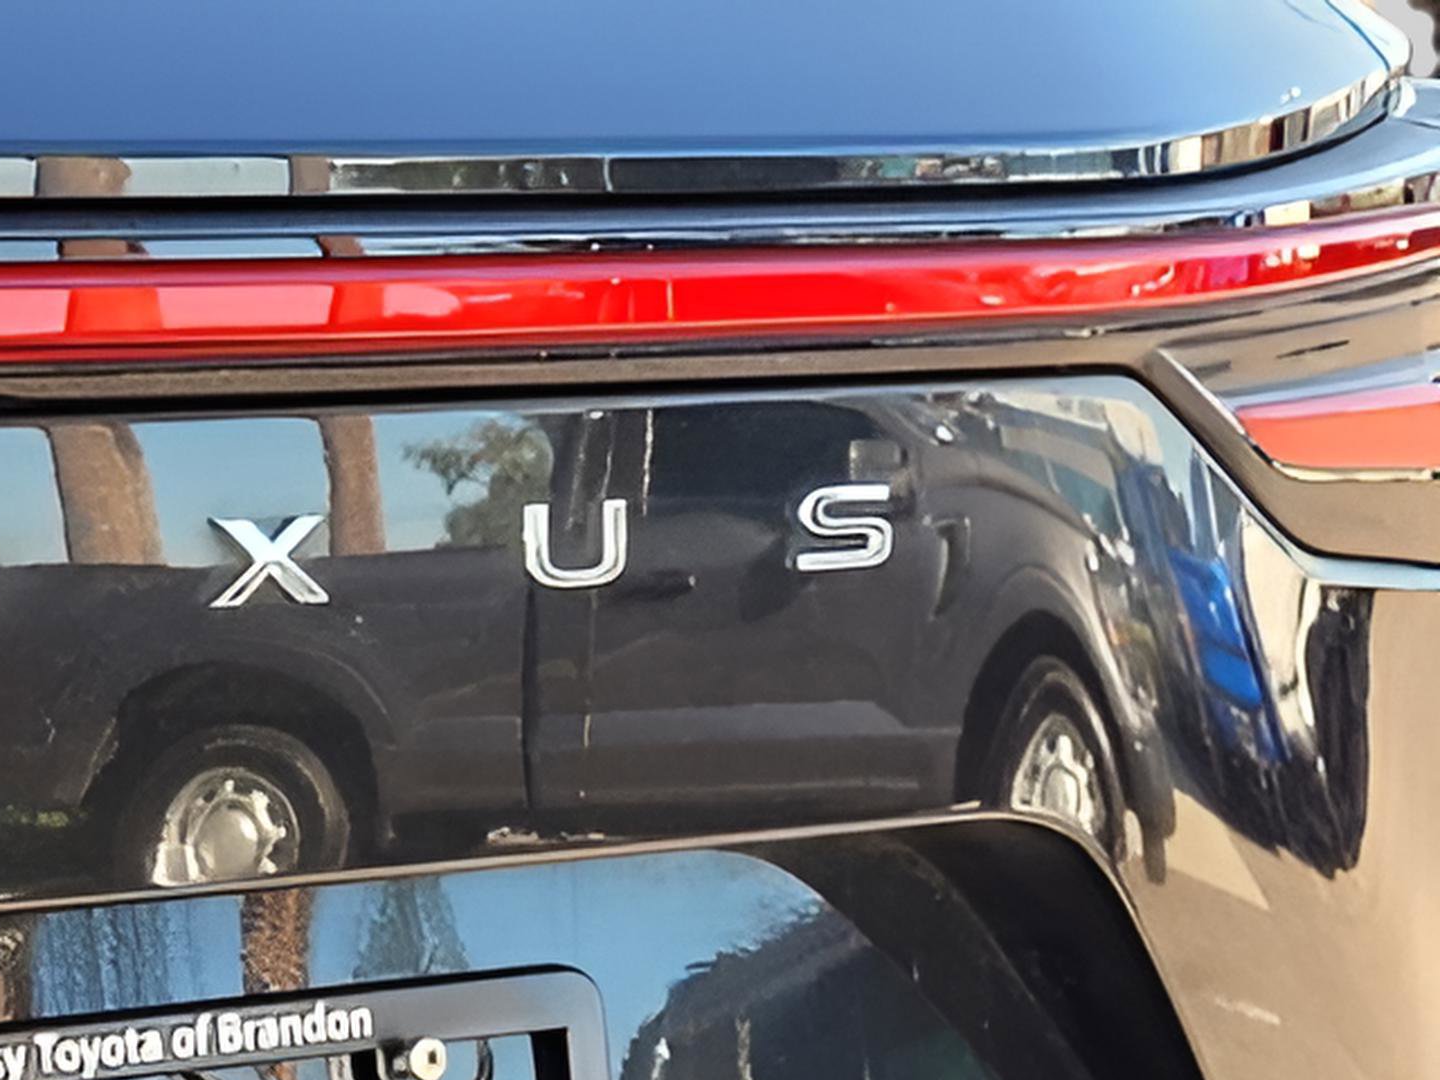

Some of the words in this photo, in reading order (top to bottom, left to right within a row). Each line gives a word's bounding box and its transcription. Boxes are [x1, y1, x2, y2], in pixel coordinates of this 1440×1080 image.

[33, 1028, 163, 1078] Toyota
[172, 1011, 215, 1058] of
[216, 1000, 374, 1054] Brandon
